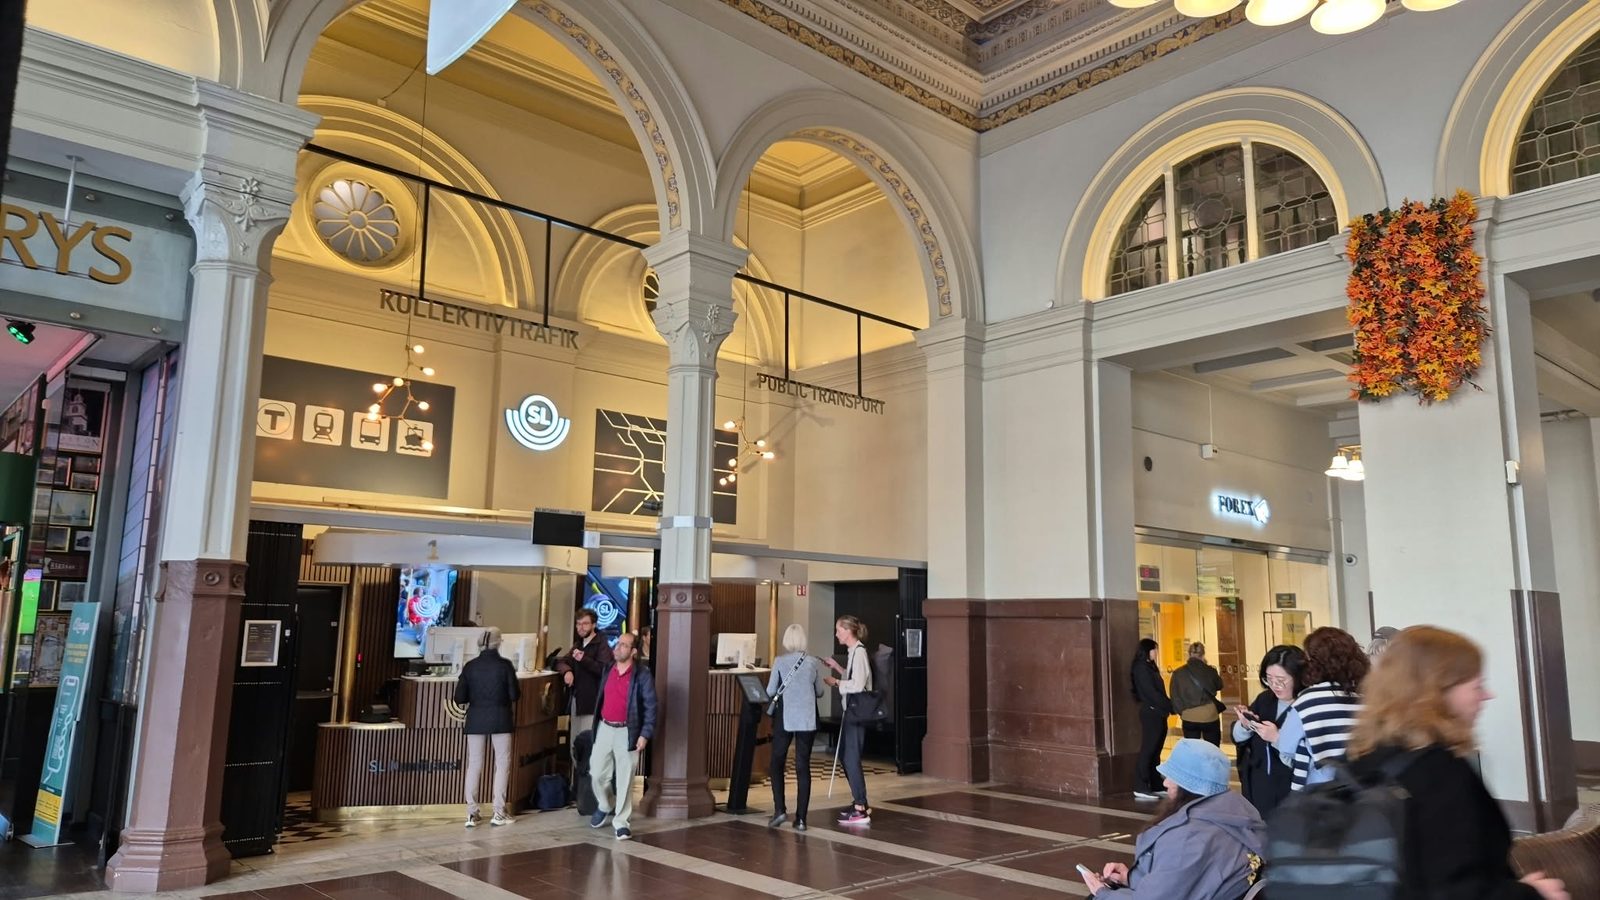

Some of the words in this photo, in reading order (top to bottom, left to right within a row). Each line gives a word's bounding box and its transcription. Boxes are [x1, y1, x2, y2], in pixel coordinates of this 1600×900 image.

[0, 203, 132, 285] RYS
[379, 289, 579, 350] KOLLEKTIVTRAFIK
[757, 373, 808, 398] PUBLIC
[811, 385, 886, 415] TRANSPORT
[527, 404, 551, 426] SL
[1217, 495, 1255, 516] FOREX
[780, 562, 786, 578] 4
[600, 605, 610, 613] SL
[369, 760, 385, 773] SL
